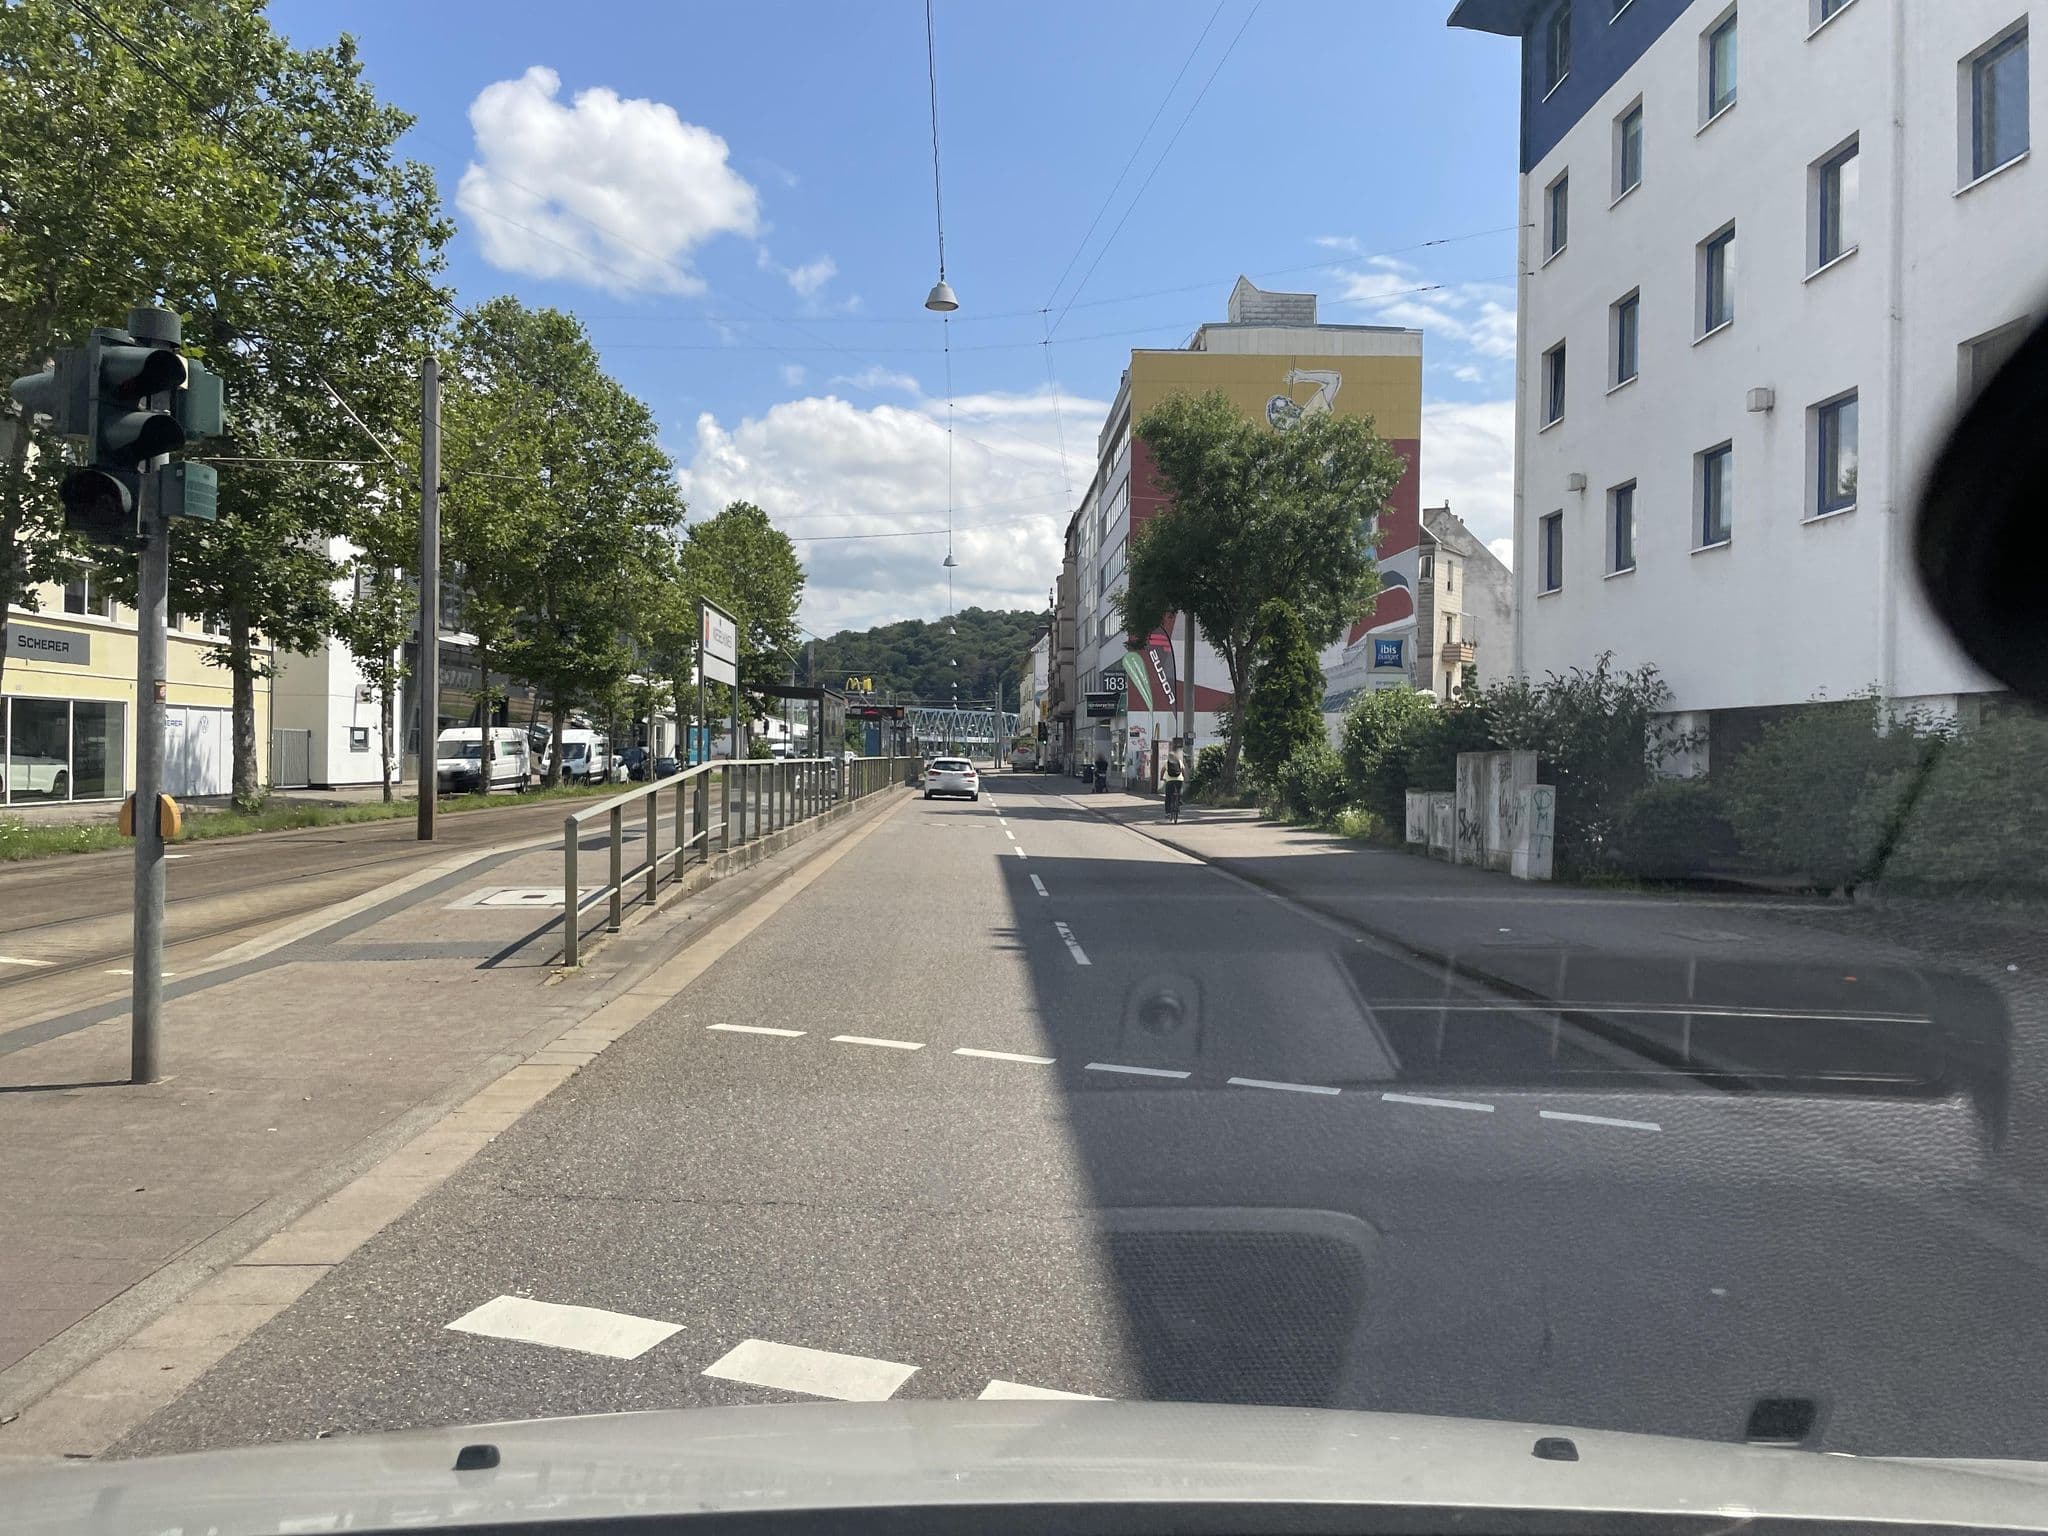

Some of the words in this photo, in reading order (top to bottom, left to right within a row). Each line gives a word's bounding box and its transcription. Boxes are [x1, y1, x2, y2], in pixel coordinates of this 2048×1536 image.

[18, 634, 70, 653] SCHERER
[1380, 645, 1397, 654] ibis
[1104, 677, 1125, 691] 183
